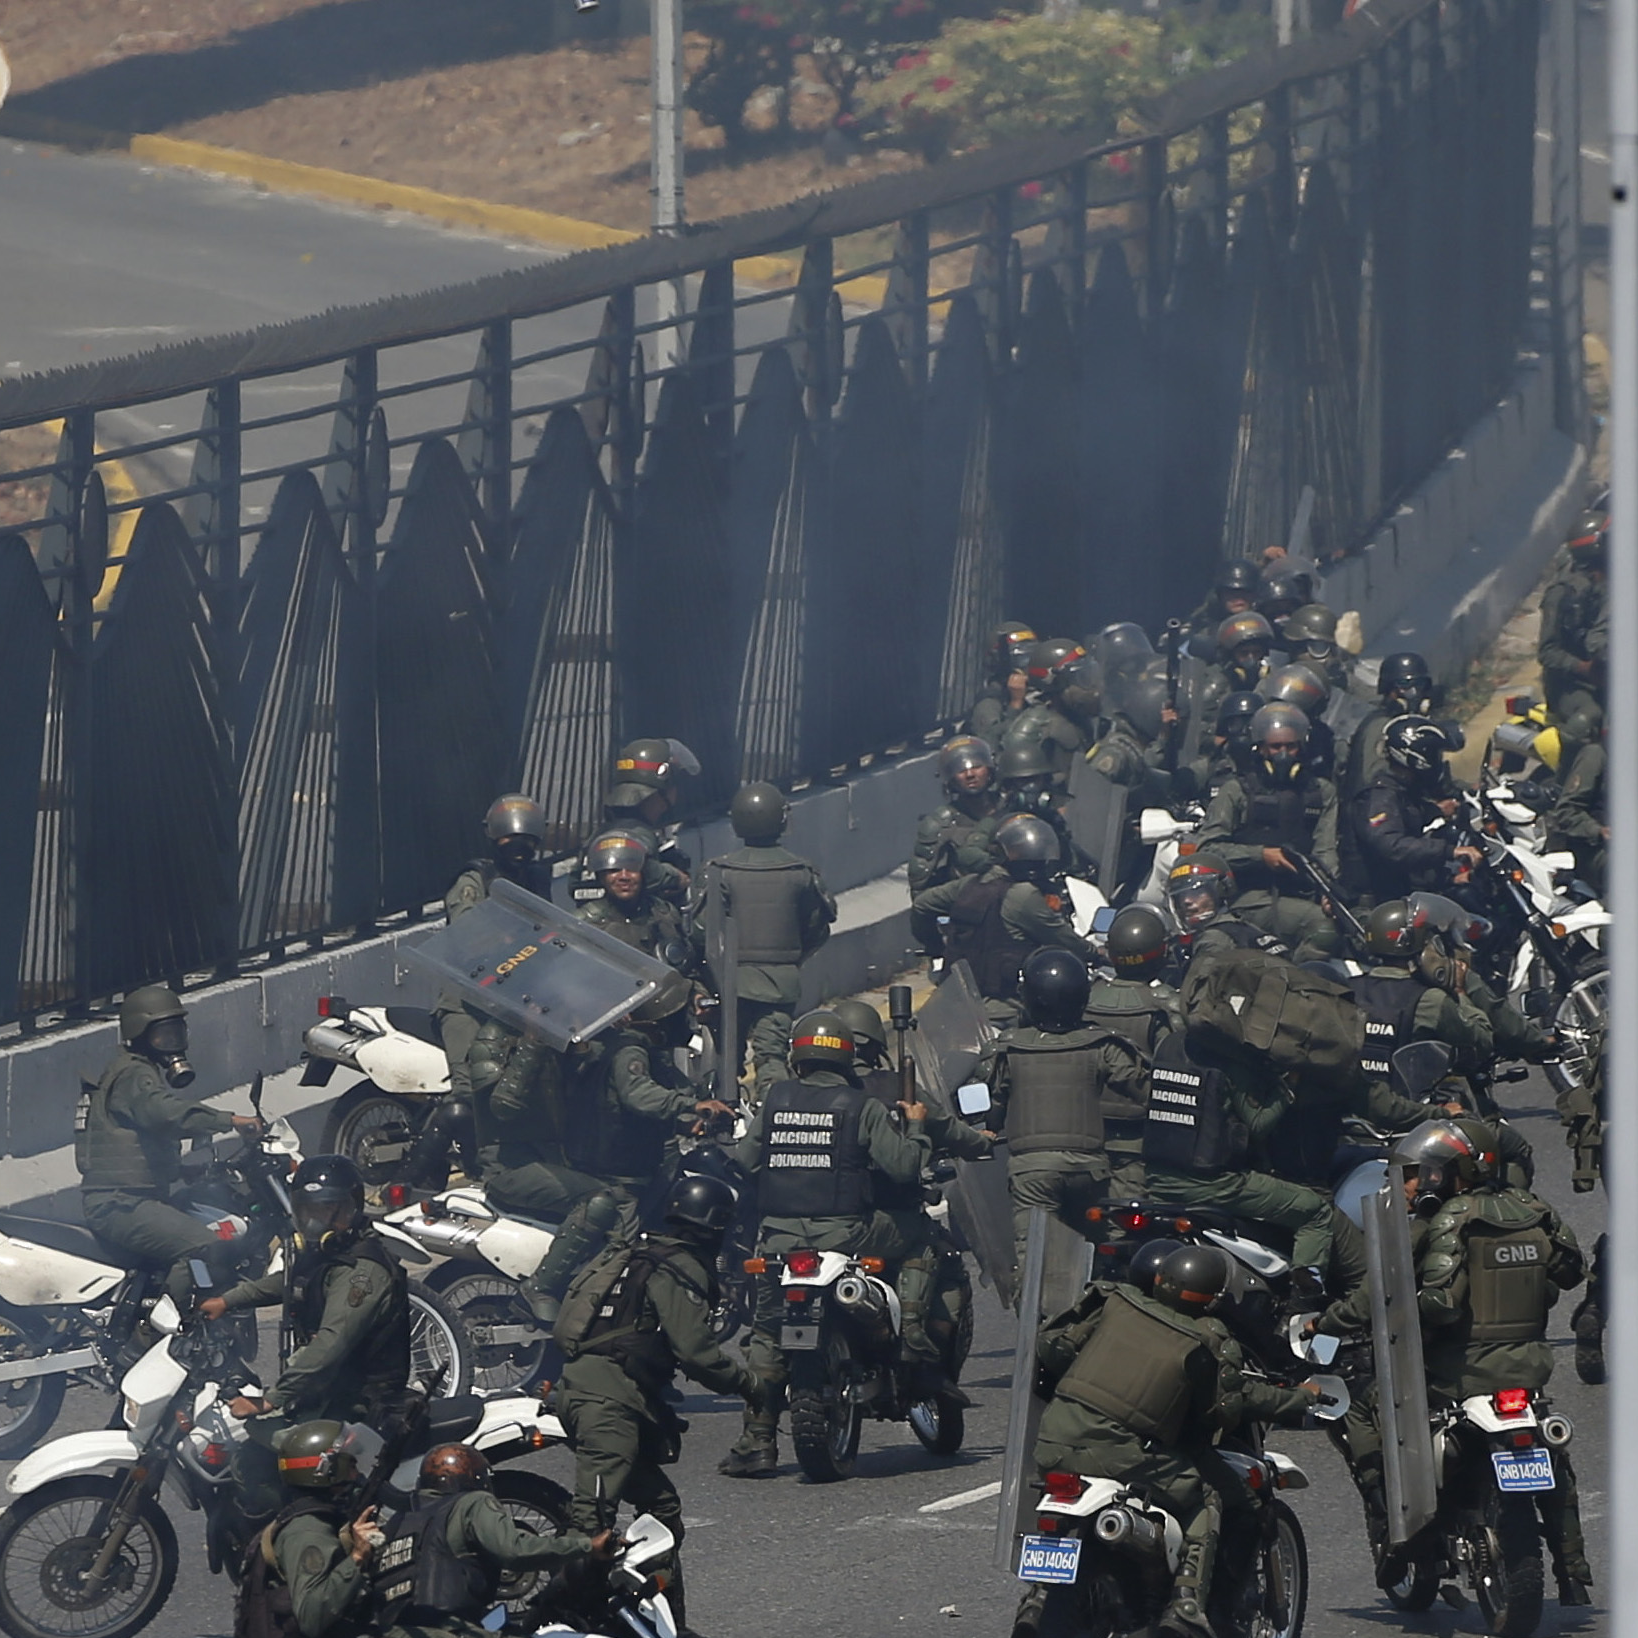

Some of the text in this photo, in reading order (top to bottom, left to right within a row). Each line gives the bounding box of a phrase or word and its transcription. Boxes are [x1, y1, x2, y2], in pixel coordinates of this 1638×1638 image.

[496, 944, 539, 975] GNB
[812, 1035, 841, 1049] GNB
[1152, 1068, 1201, 1087] GUARDIA
[1151, 1089, 1197, 1107] NACIONAL
[773, 1111, 834, 1127] GUARDIA
[770, 1131, 833, 1145] NACIONAL
[769, 1153, 831, 1168] BOLIVARIANA
[1494, 1244, 1539, 1263] GNB
[1498, 1461, 1551, 1479] GNB14206
[1023, 1549, 1077, 1570] GNB14060
